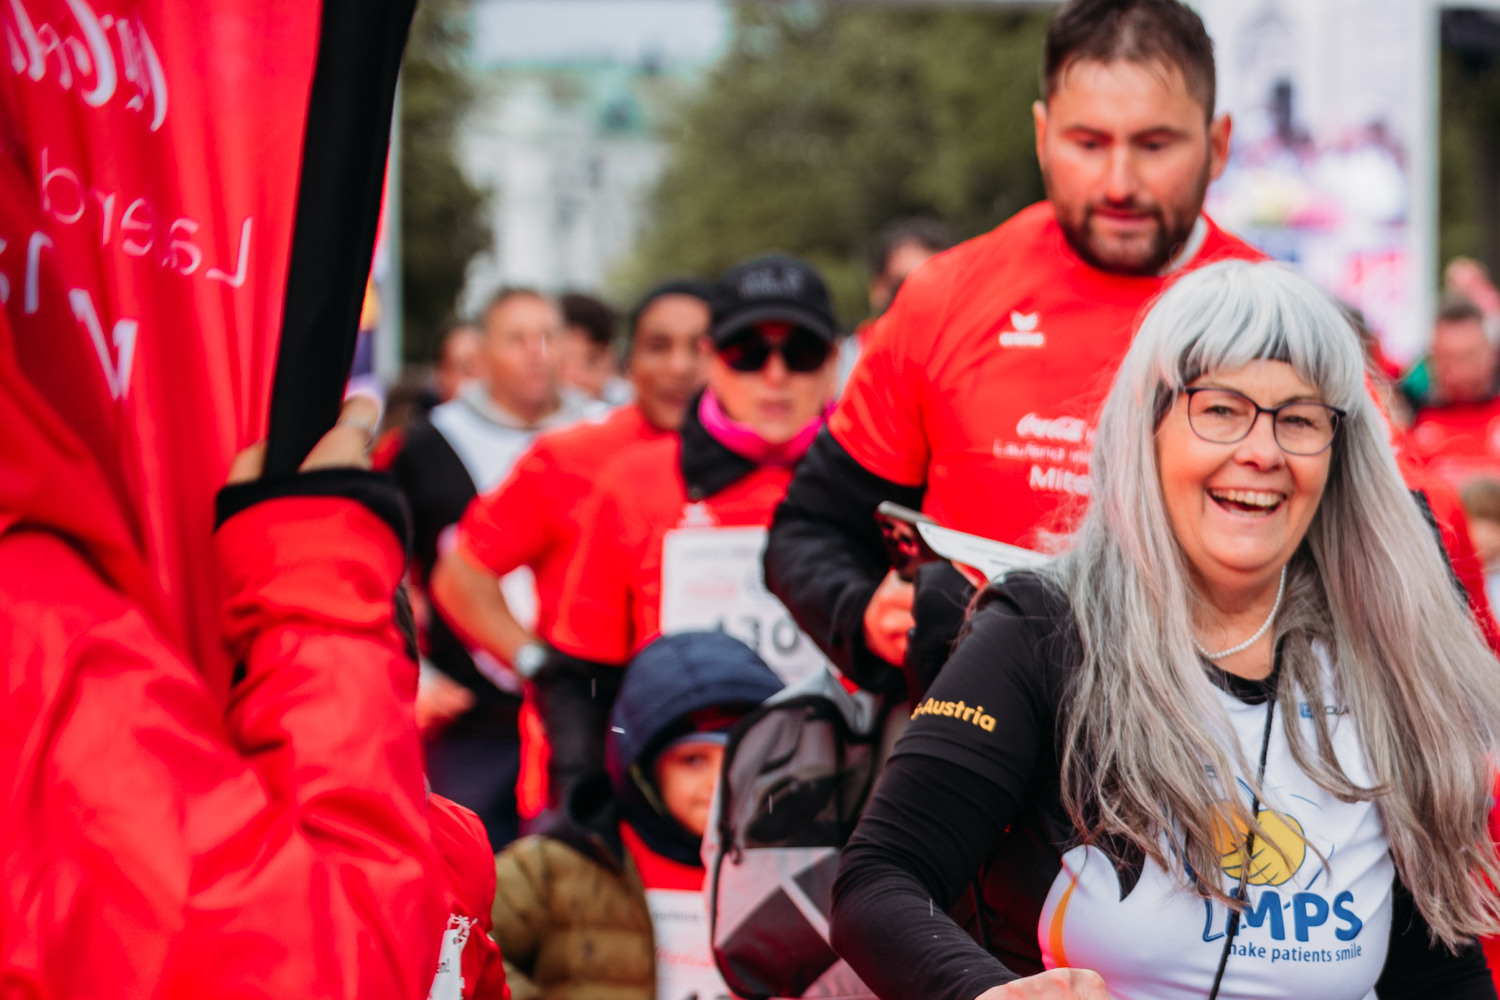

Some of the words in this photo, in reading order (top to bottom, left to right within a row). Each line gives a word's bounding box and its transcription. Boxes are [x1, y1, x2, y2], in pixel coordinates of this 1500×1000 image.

[1226, 886, 1363, 942] MPS
[1271, 946, 1333, 963] patients
[1335, 942, 1362, 962] smile
